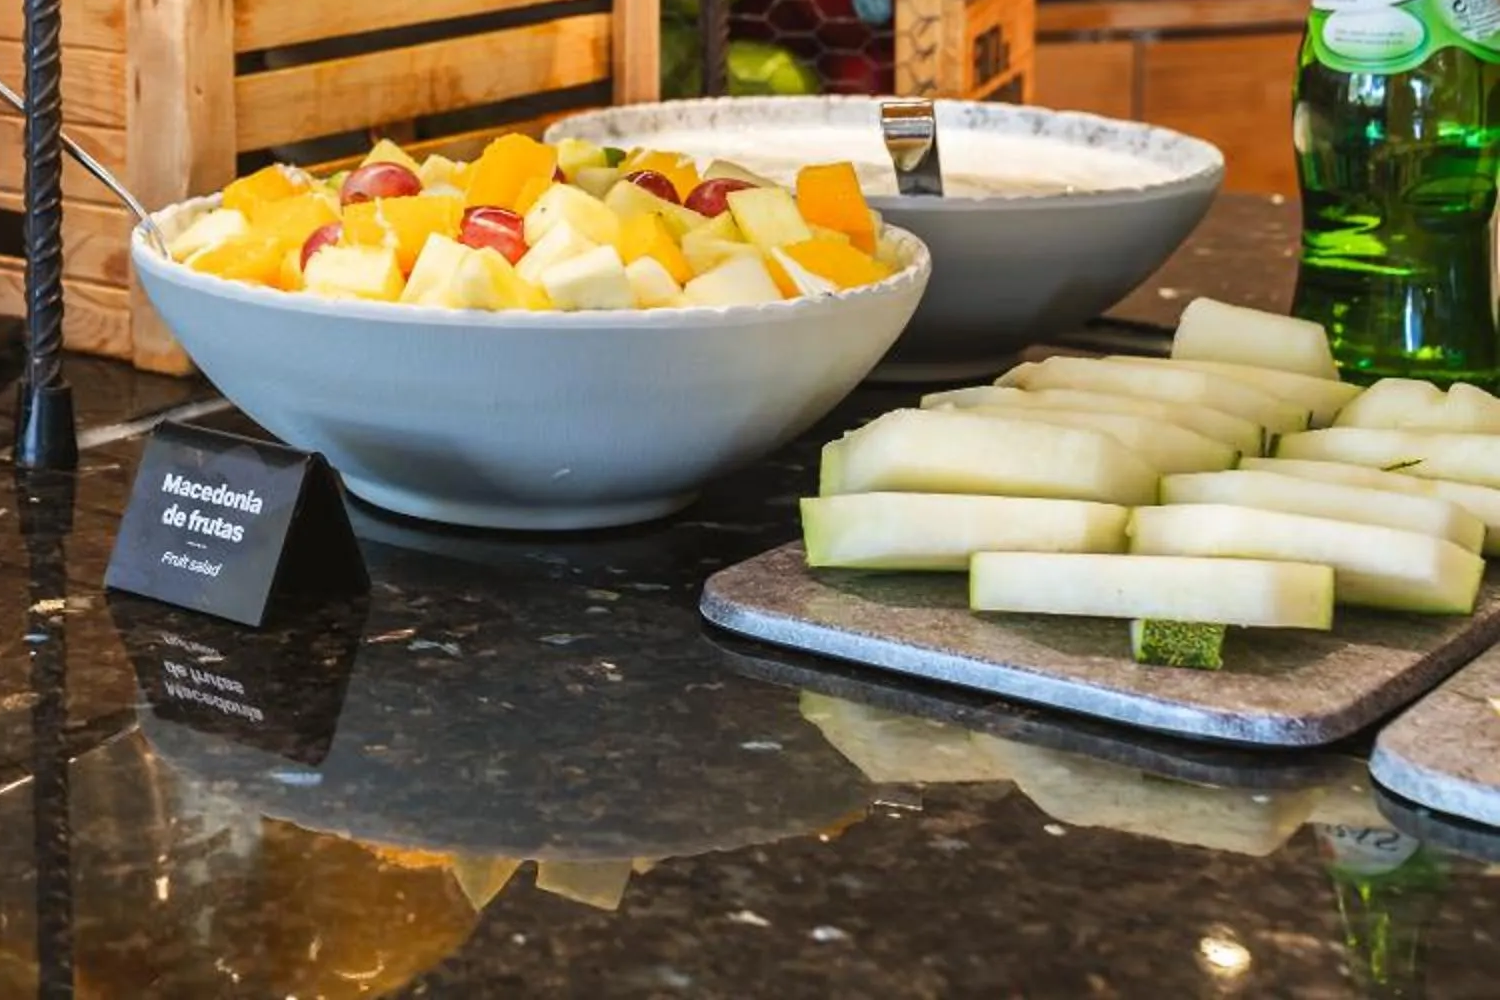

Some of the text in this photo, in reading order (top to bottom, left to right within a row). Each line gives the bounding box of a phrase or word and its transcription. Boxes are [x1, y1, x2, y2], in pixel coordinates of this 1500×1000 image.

[162, 473, 263, 515] Macedonia
[162, 503, 245, 543] de frutas
[161, 551, 223, 577] Fruit salad
